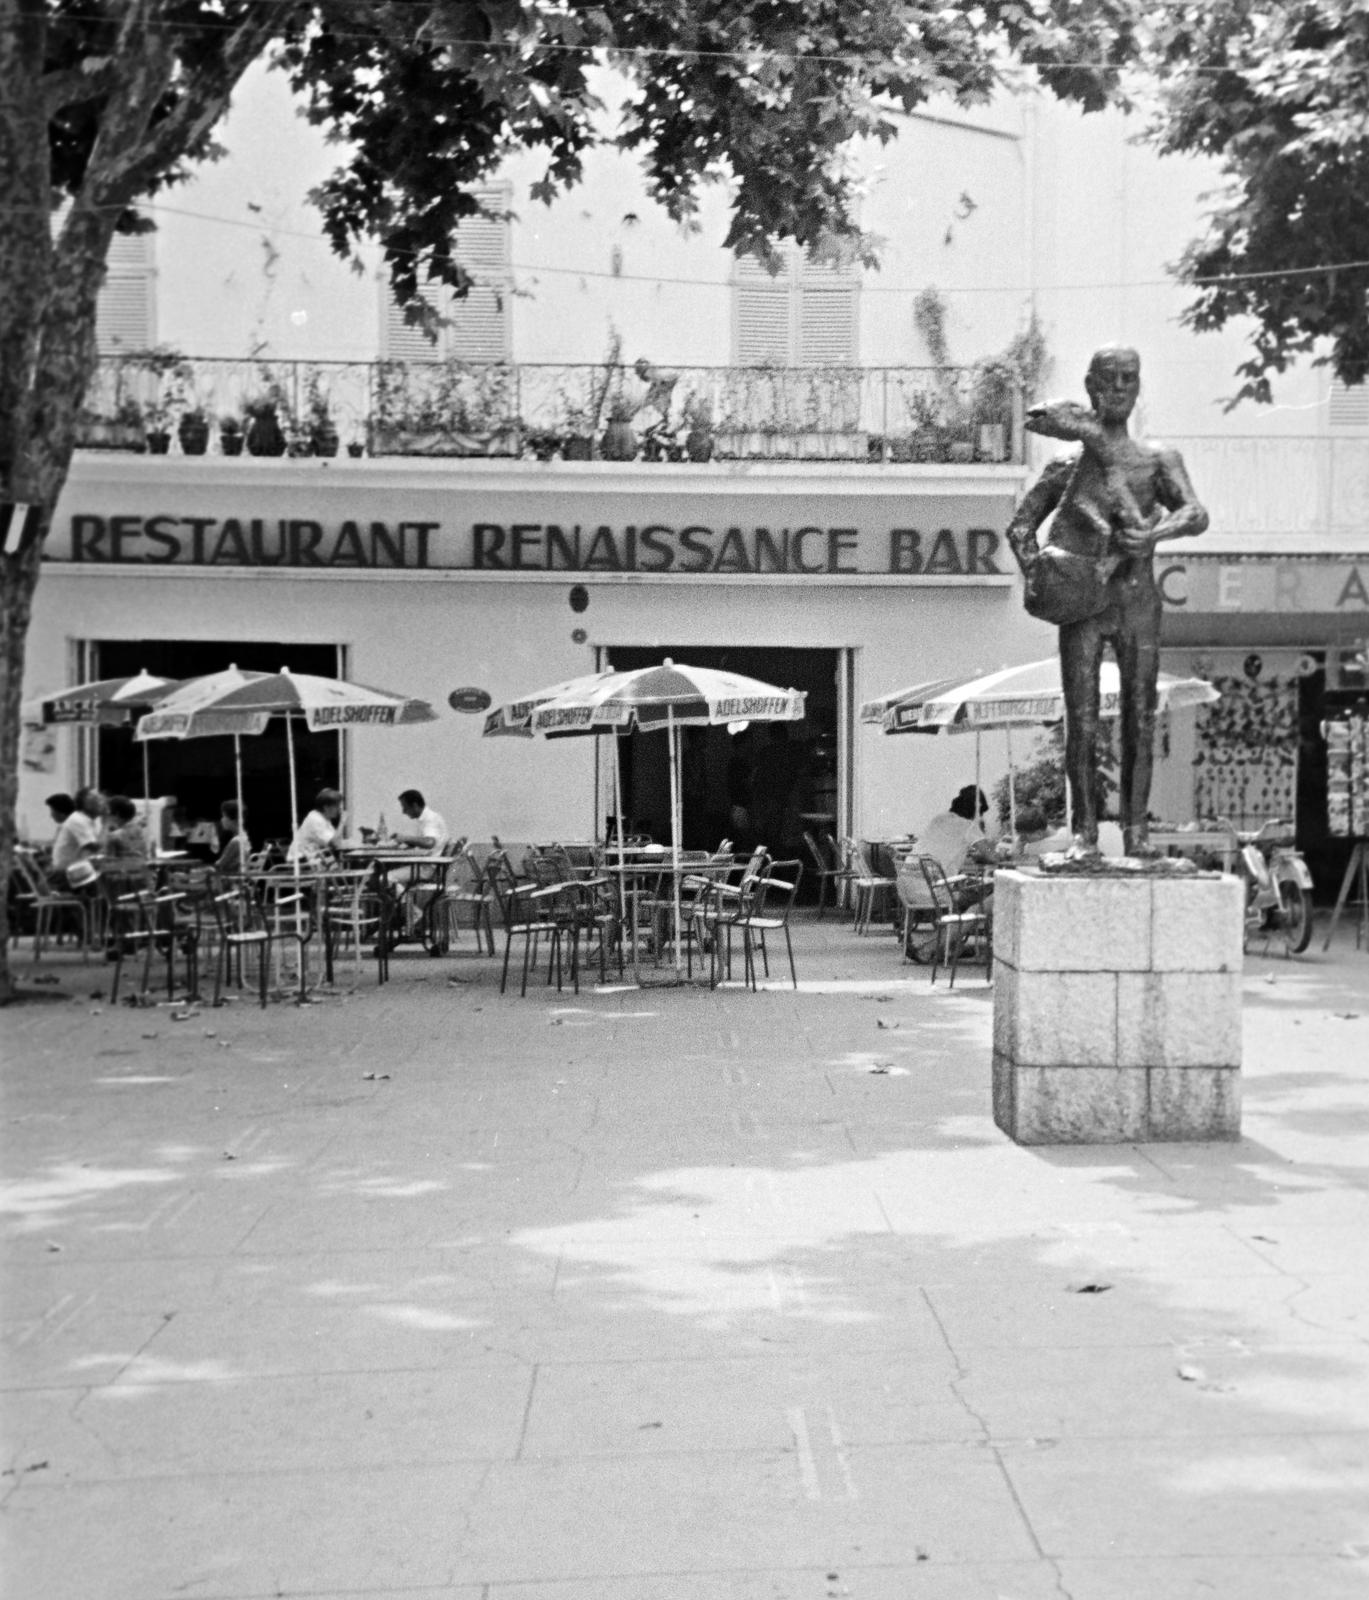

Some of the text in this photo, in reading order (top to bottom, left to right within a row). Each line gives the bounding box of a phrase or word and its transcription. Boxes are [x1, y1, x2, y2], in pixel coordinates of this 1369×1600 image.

[71, 514, 1001, 574] RESTAURANT RENAISSANCE BAR
[313, 705, 397, 725] ADELSHOFFEN
[536, 706, 593, 728] ADELSHOFFEN
[716, 698, 788, 717] ADELSHOFFEN
